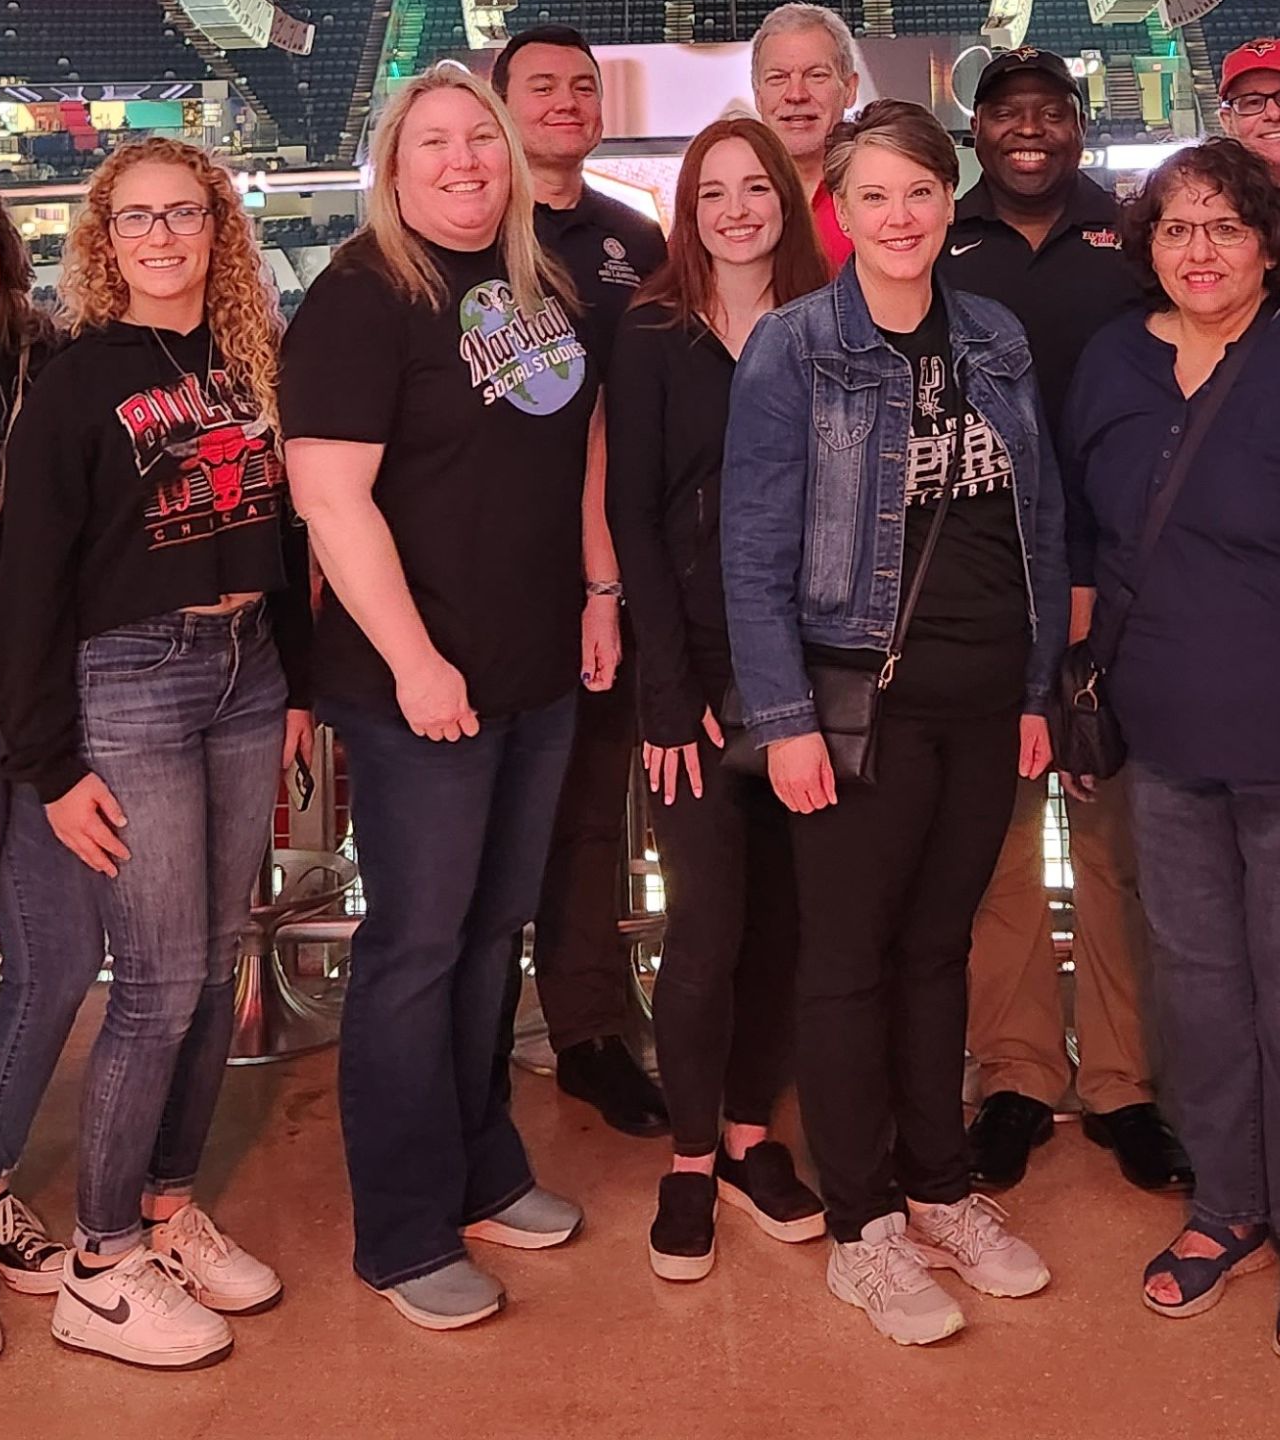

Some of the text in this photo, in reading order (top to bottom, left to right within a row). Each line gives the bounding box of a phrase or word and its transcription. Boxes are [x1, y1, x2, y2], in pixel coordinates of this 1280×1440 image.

[459, 295, 577, 389] Marshall
[483, 340, 588, 406] SOCIAL STUDIES
[115, 369, 270, 478] BULL
[153, 501, 276, 541] CHICA
